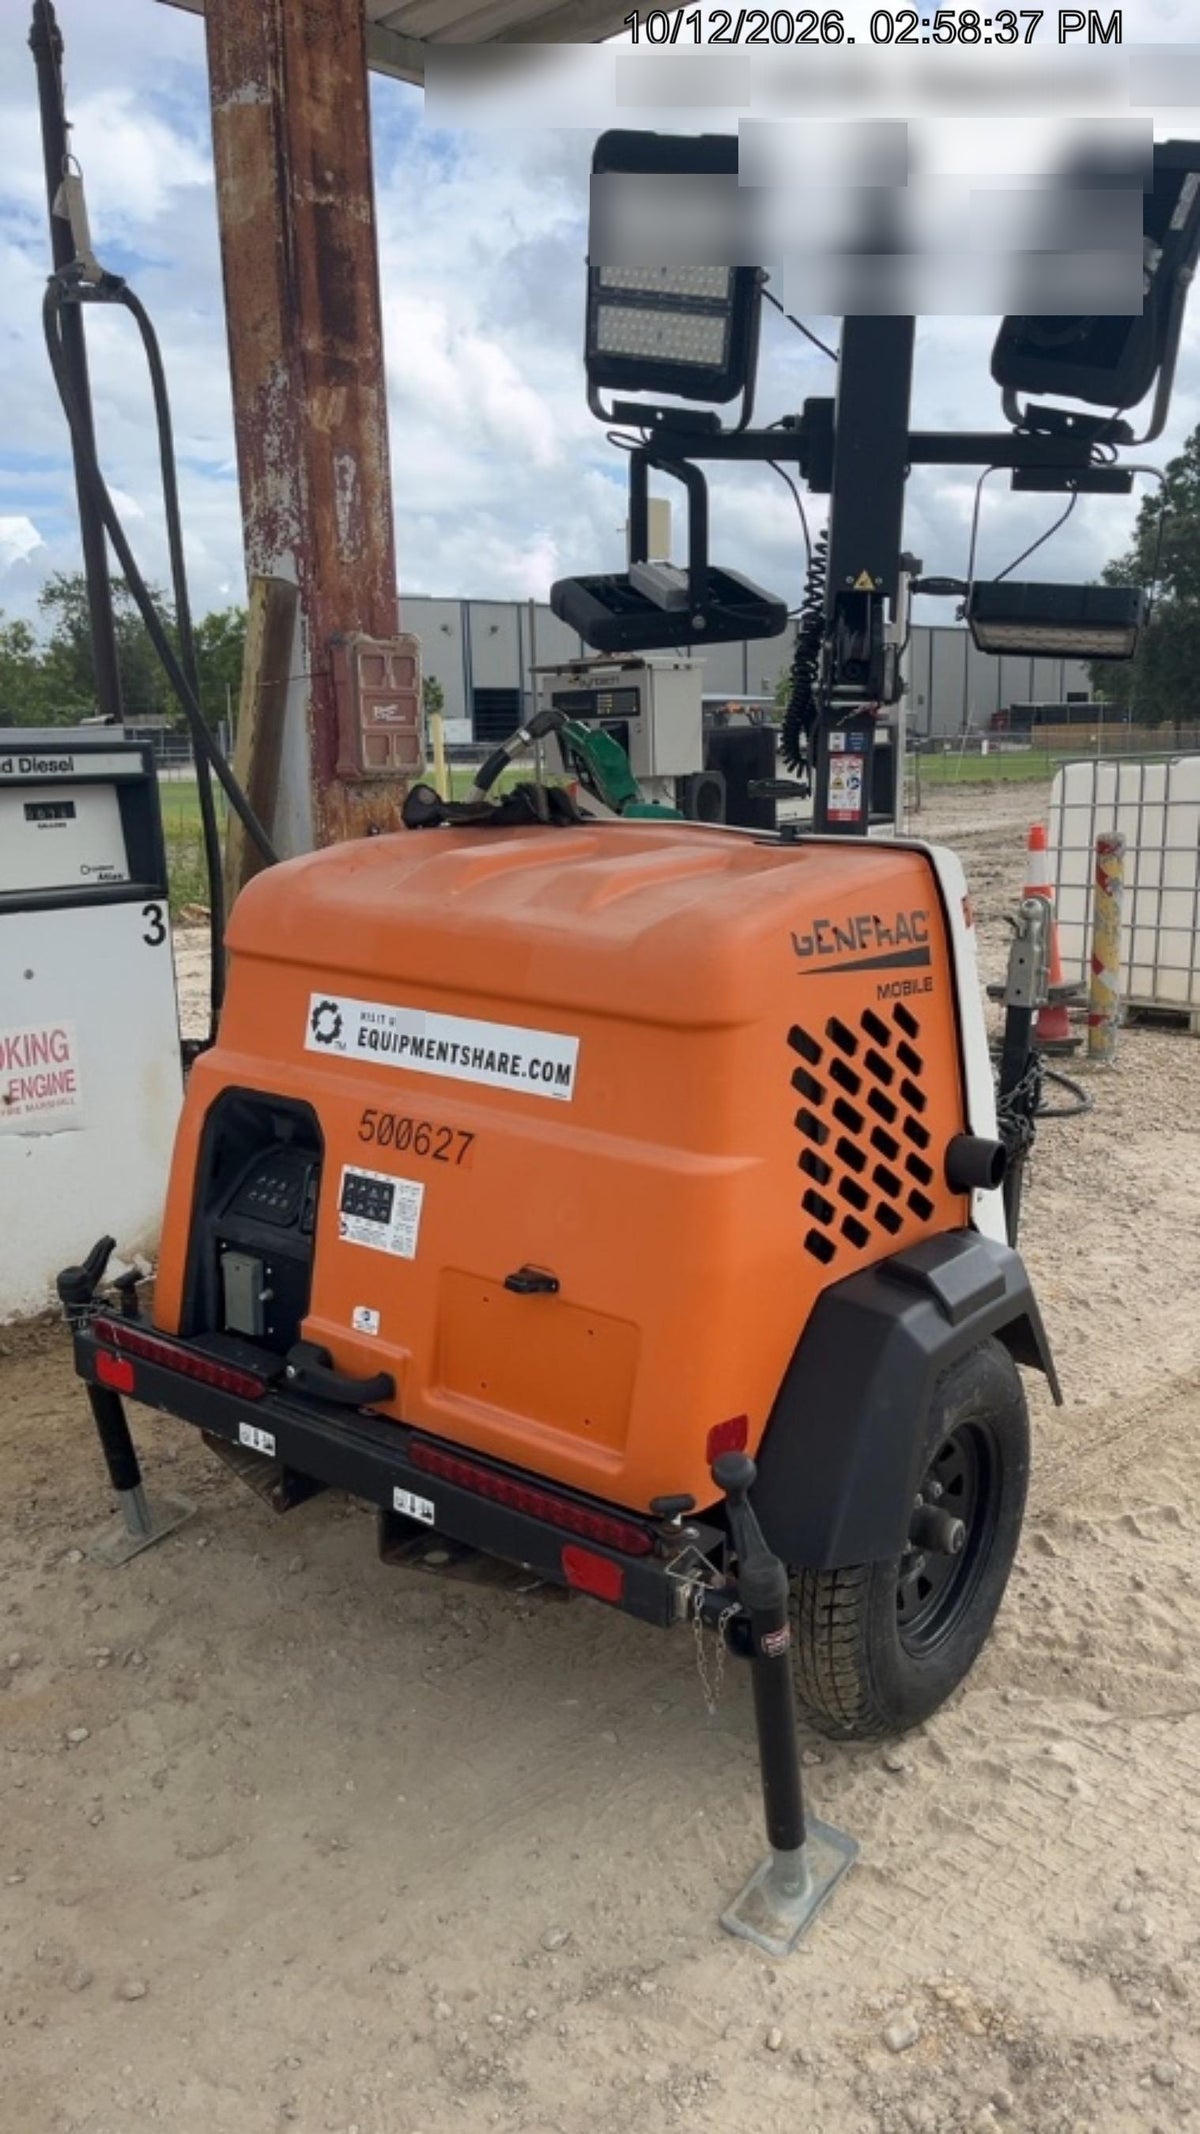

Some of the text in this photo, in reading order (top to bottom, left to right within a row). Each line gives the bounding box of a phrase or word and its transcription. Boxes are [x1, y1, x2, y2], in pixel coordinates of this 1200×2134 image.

[19, 756, 74, 774] Diesel
[142, 903, 167, 946] 3
[877, 976, 934, 1000] MOBILE
[357, 1027, 572, 1086] EQUIPMENTSHARE.COM
[9, 1069, 77, 1102] ENGINE
[358, 1109, 475, 1165] 500627
